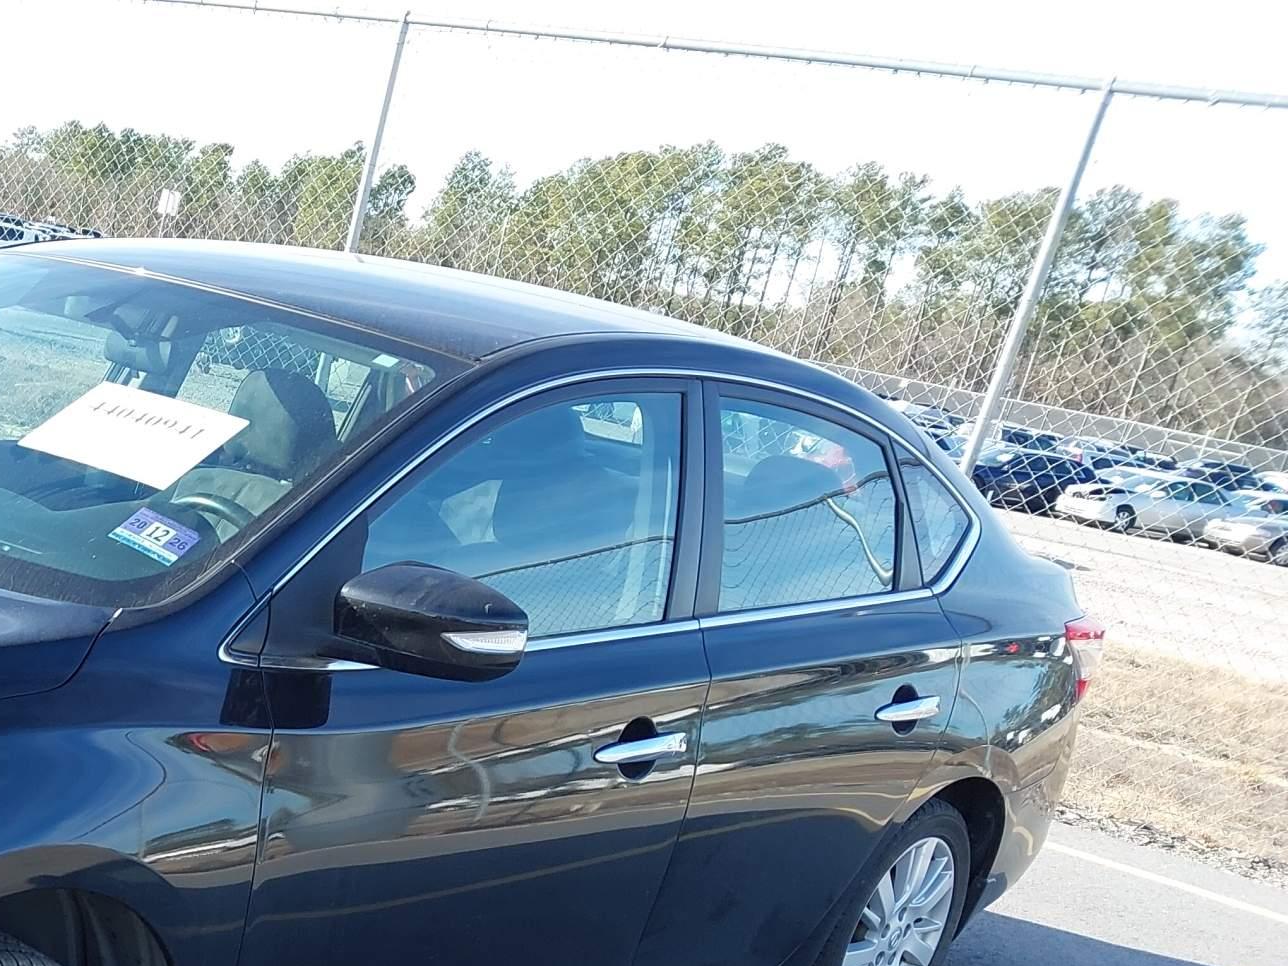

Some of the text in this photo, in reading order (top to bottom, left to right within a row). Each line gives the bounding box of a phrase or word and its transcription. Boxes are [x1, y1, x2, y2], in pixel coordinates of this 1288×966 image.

[129, 518, 148, 529] 20
[145, 526, 170, 542] 12
[169, 537, 188, 550] 26
